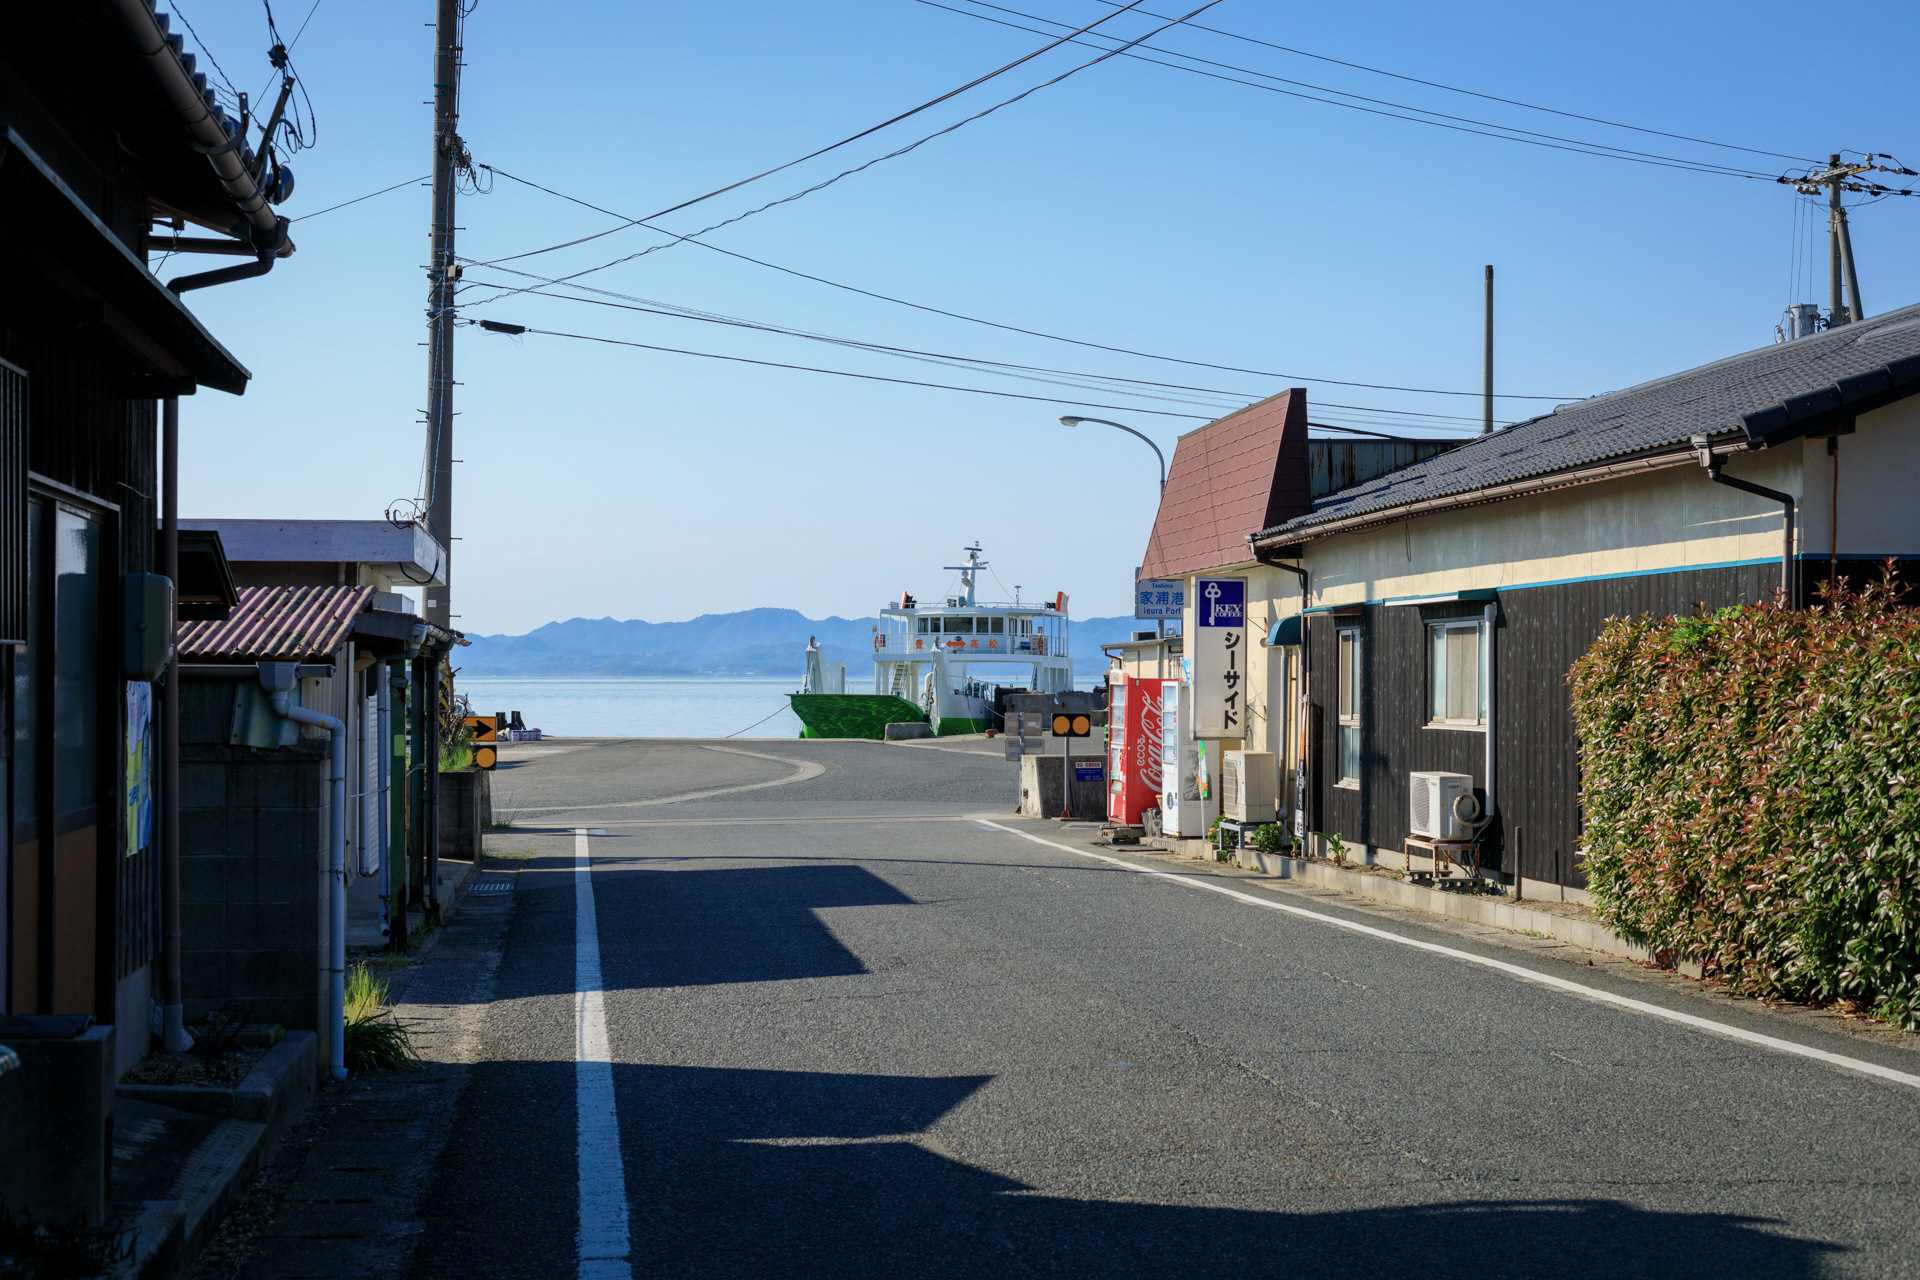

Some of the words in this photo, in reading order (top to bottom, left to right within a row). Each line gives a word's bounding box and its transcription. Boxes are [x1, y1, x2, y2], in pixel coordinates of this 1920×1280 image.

[1140, 591, 1184, 605] 家浦港
[1215, 604, 1242, 612] KEY
[970, 639, 997, 649] 高松
[1224, 631, 1240, 729] シーサイド
